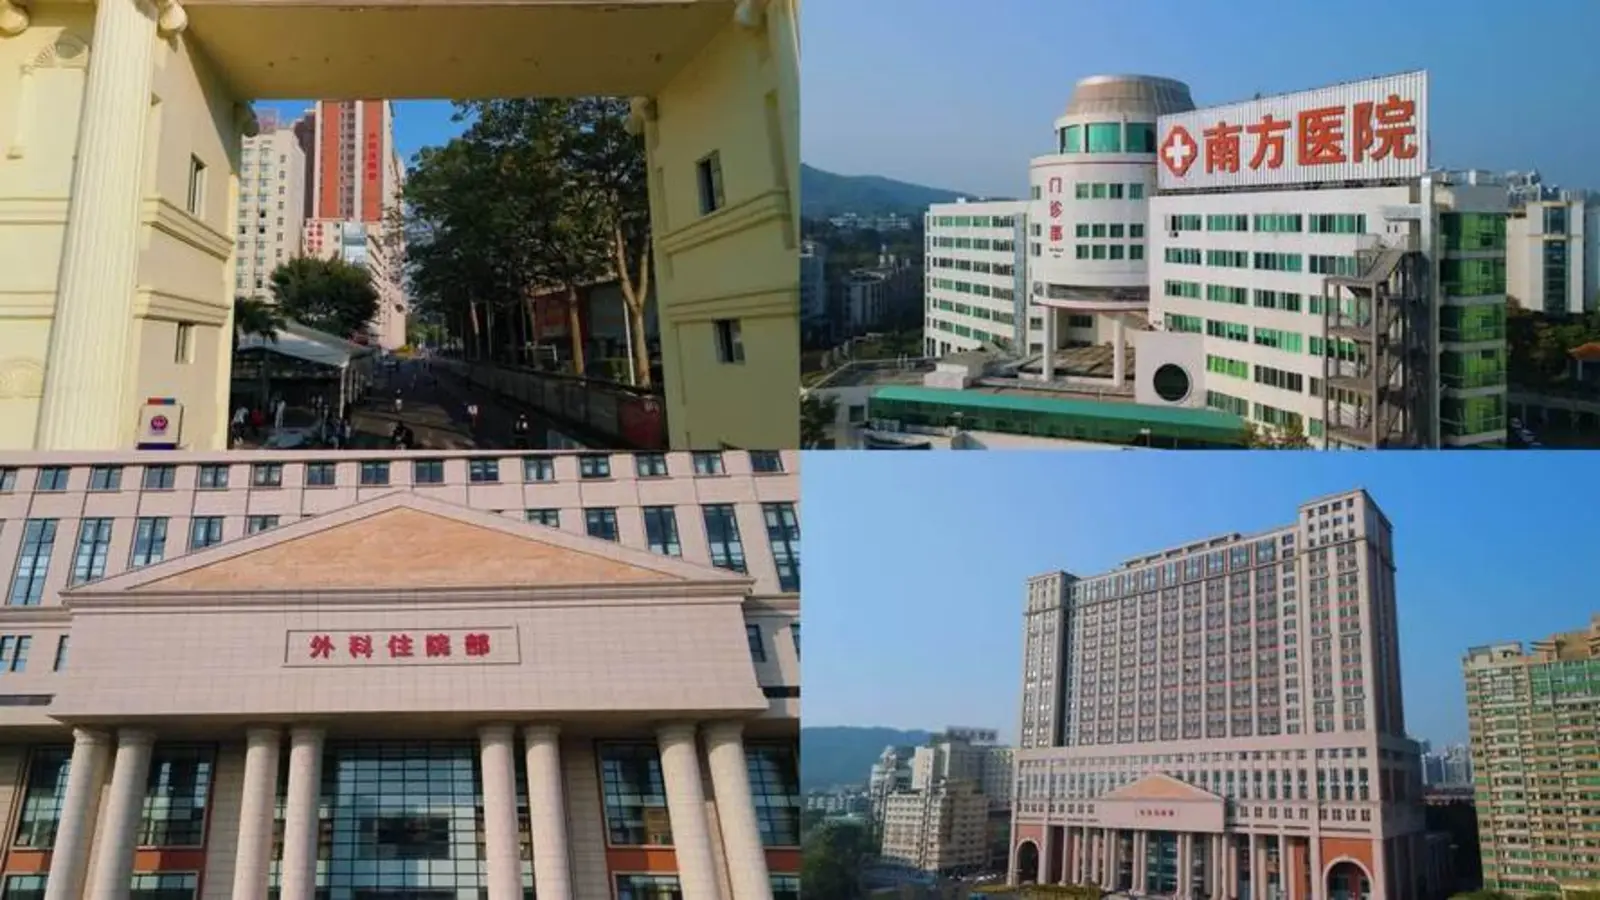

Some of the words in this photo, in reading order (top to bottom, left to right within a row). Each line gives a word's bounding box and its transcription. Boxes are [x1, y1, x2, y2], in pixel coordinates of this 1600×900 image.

[1203, 94, 1419, 174] 南方医院
[310, 633, 491, 658] 外科住院部
